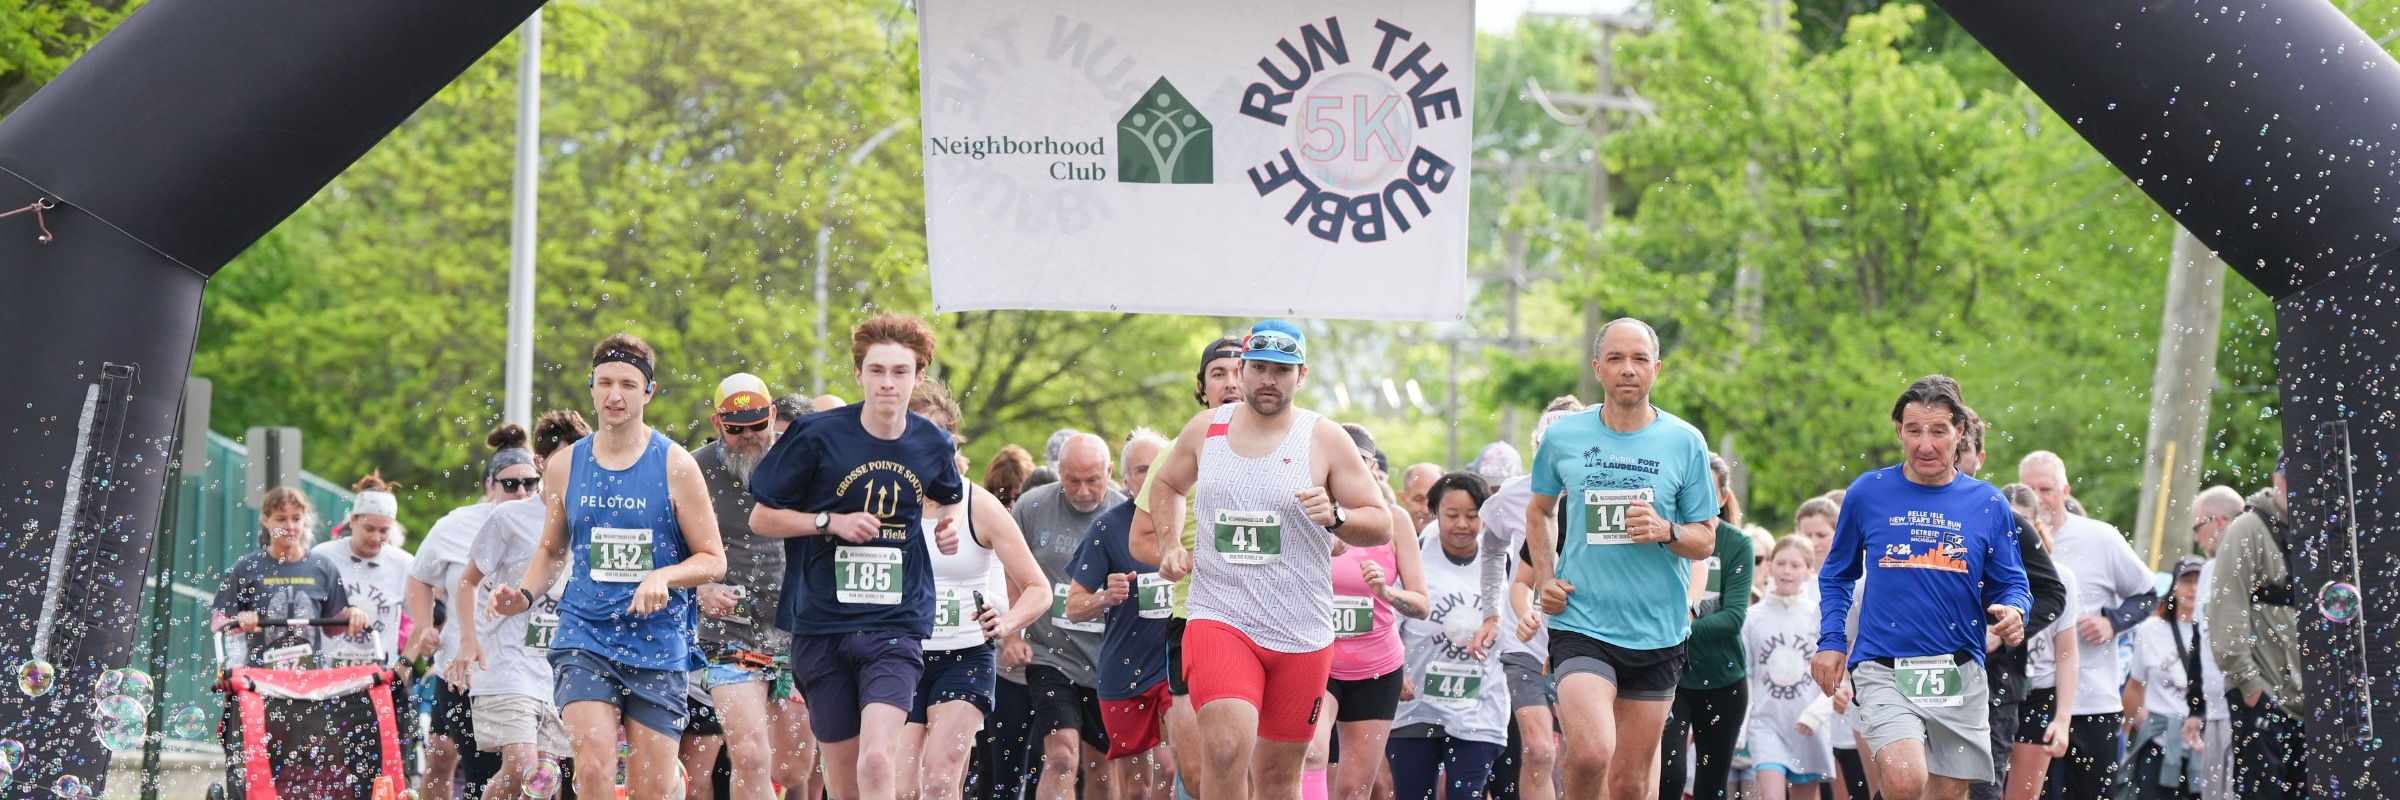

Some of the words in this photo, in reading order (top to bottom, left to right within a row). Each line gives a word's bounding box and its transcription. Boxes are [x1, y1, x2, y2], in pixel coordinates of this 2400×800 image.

[1239, 16, 1350, 127] RUN
[1371, 17, 1462, 129] THE
[1300, 95, 1405, 162] 5K
[931, 135, 1106, 160] Neighborhood
[1049, 161, 1106, 181] Club
[1247, 145, 1456, 243] BUBBLE
[1603, 461, 1659, 475] LAUDERDALE
[1637, 458, 1660, 468] FORT
[836, 463, 869, 497] GROSSE
[868, 460, 905, 475] POINTE
[903, 469, 923, 503] SOUTH
[580, 495, 647, 509] PELOTON
[1907, 510, 1928, 518] BELLE
[1930, 512, 1944, 520] ISLE
[882, 529, 906, 540] Field
[1907, 516, 1930, 524] YEAR'S
[1947, 520, 1961, 528] RUN
[1232, 526, 1261, 552] 41
[600, 543, 643, 570] 152
[844, 562, 892, 591] 185
[368, 584, 390, 615] THE
[1429, 592, 1465, 625] RUN
[1333, 608, 1357, 632] 30
[1759, 632, 1785, 665] RUN
[1438, 676, 1466, 697] 44
[1914, 669, 1946, 695] 75
